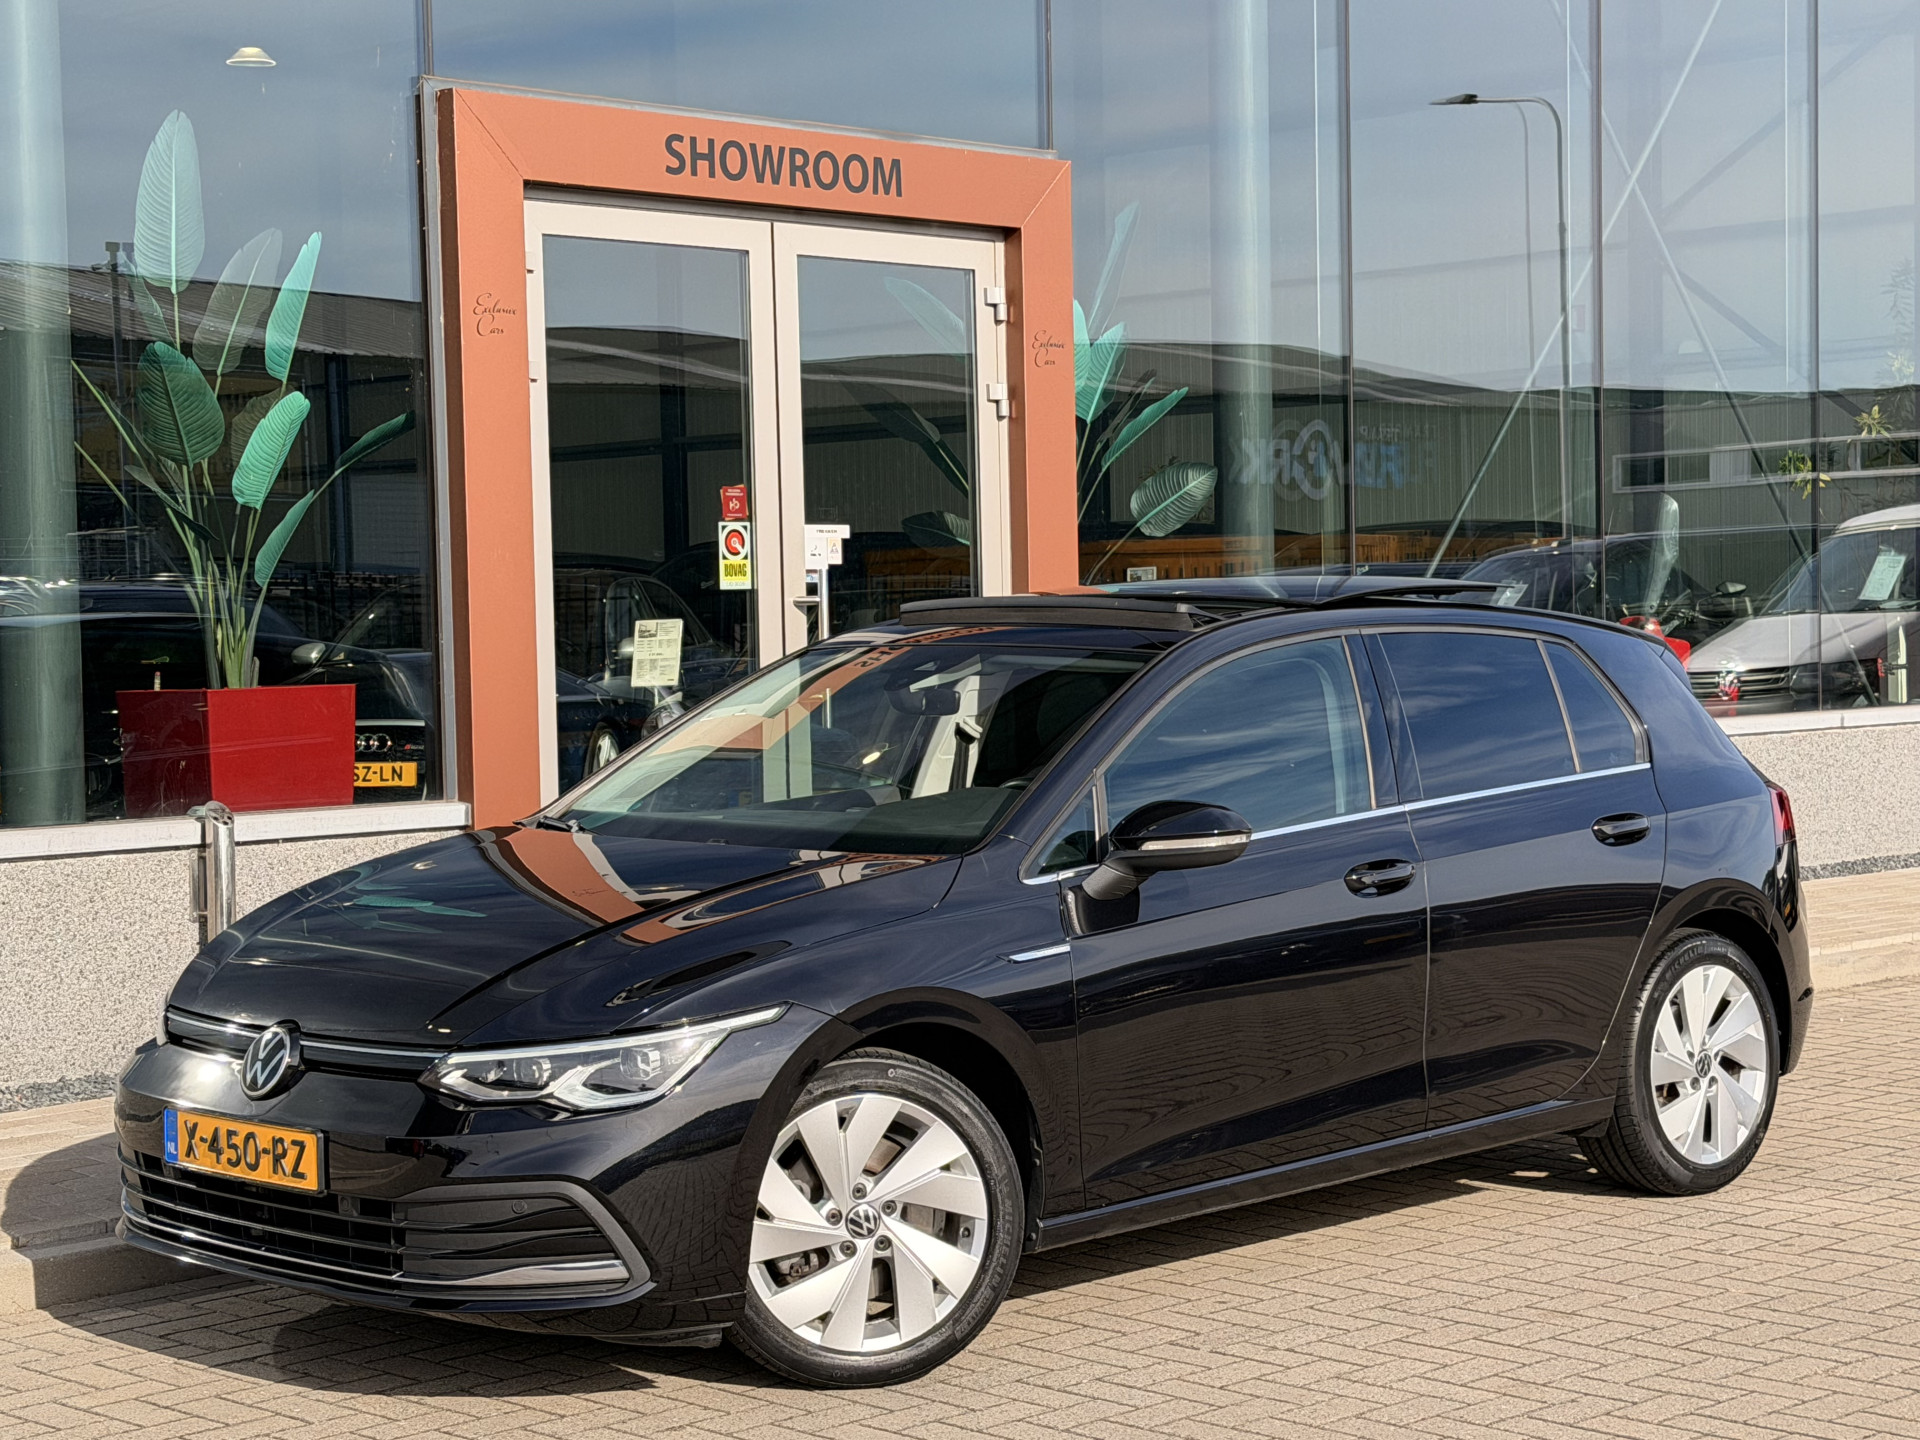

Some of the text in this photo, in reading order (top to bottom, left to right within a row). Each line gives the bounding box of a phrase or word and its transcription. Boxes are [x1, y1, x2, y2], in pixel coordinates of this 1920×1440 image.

[664, 133, 903, 198] SHOWROOM
[724, 563, 747, 578] BOVAG
[167, 1141, 178, 1155] NL
[184, 1119, 308, 1181] X-450-RZ
